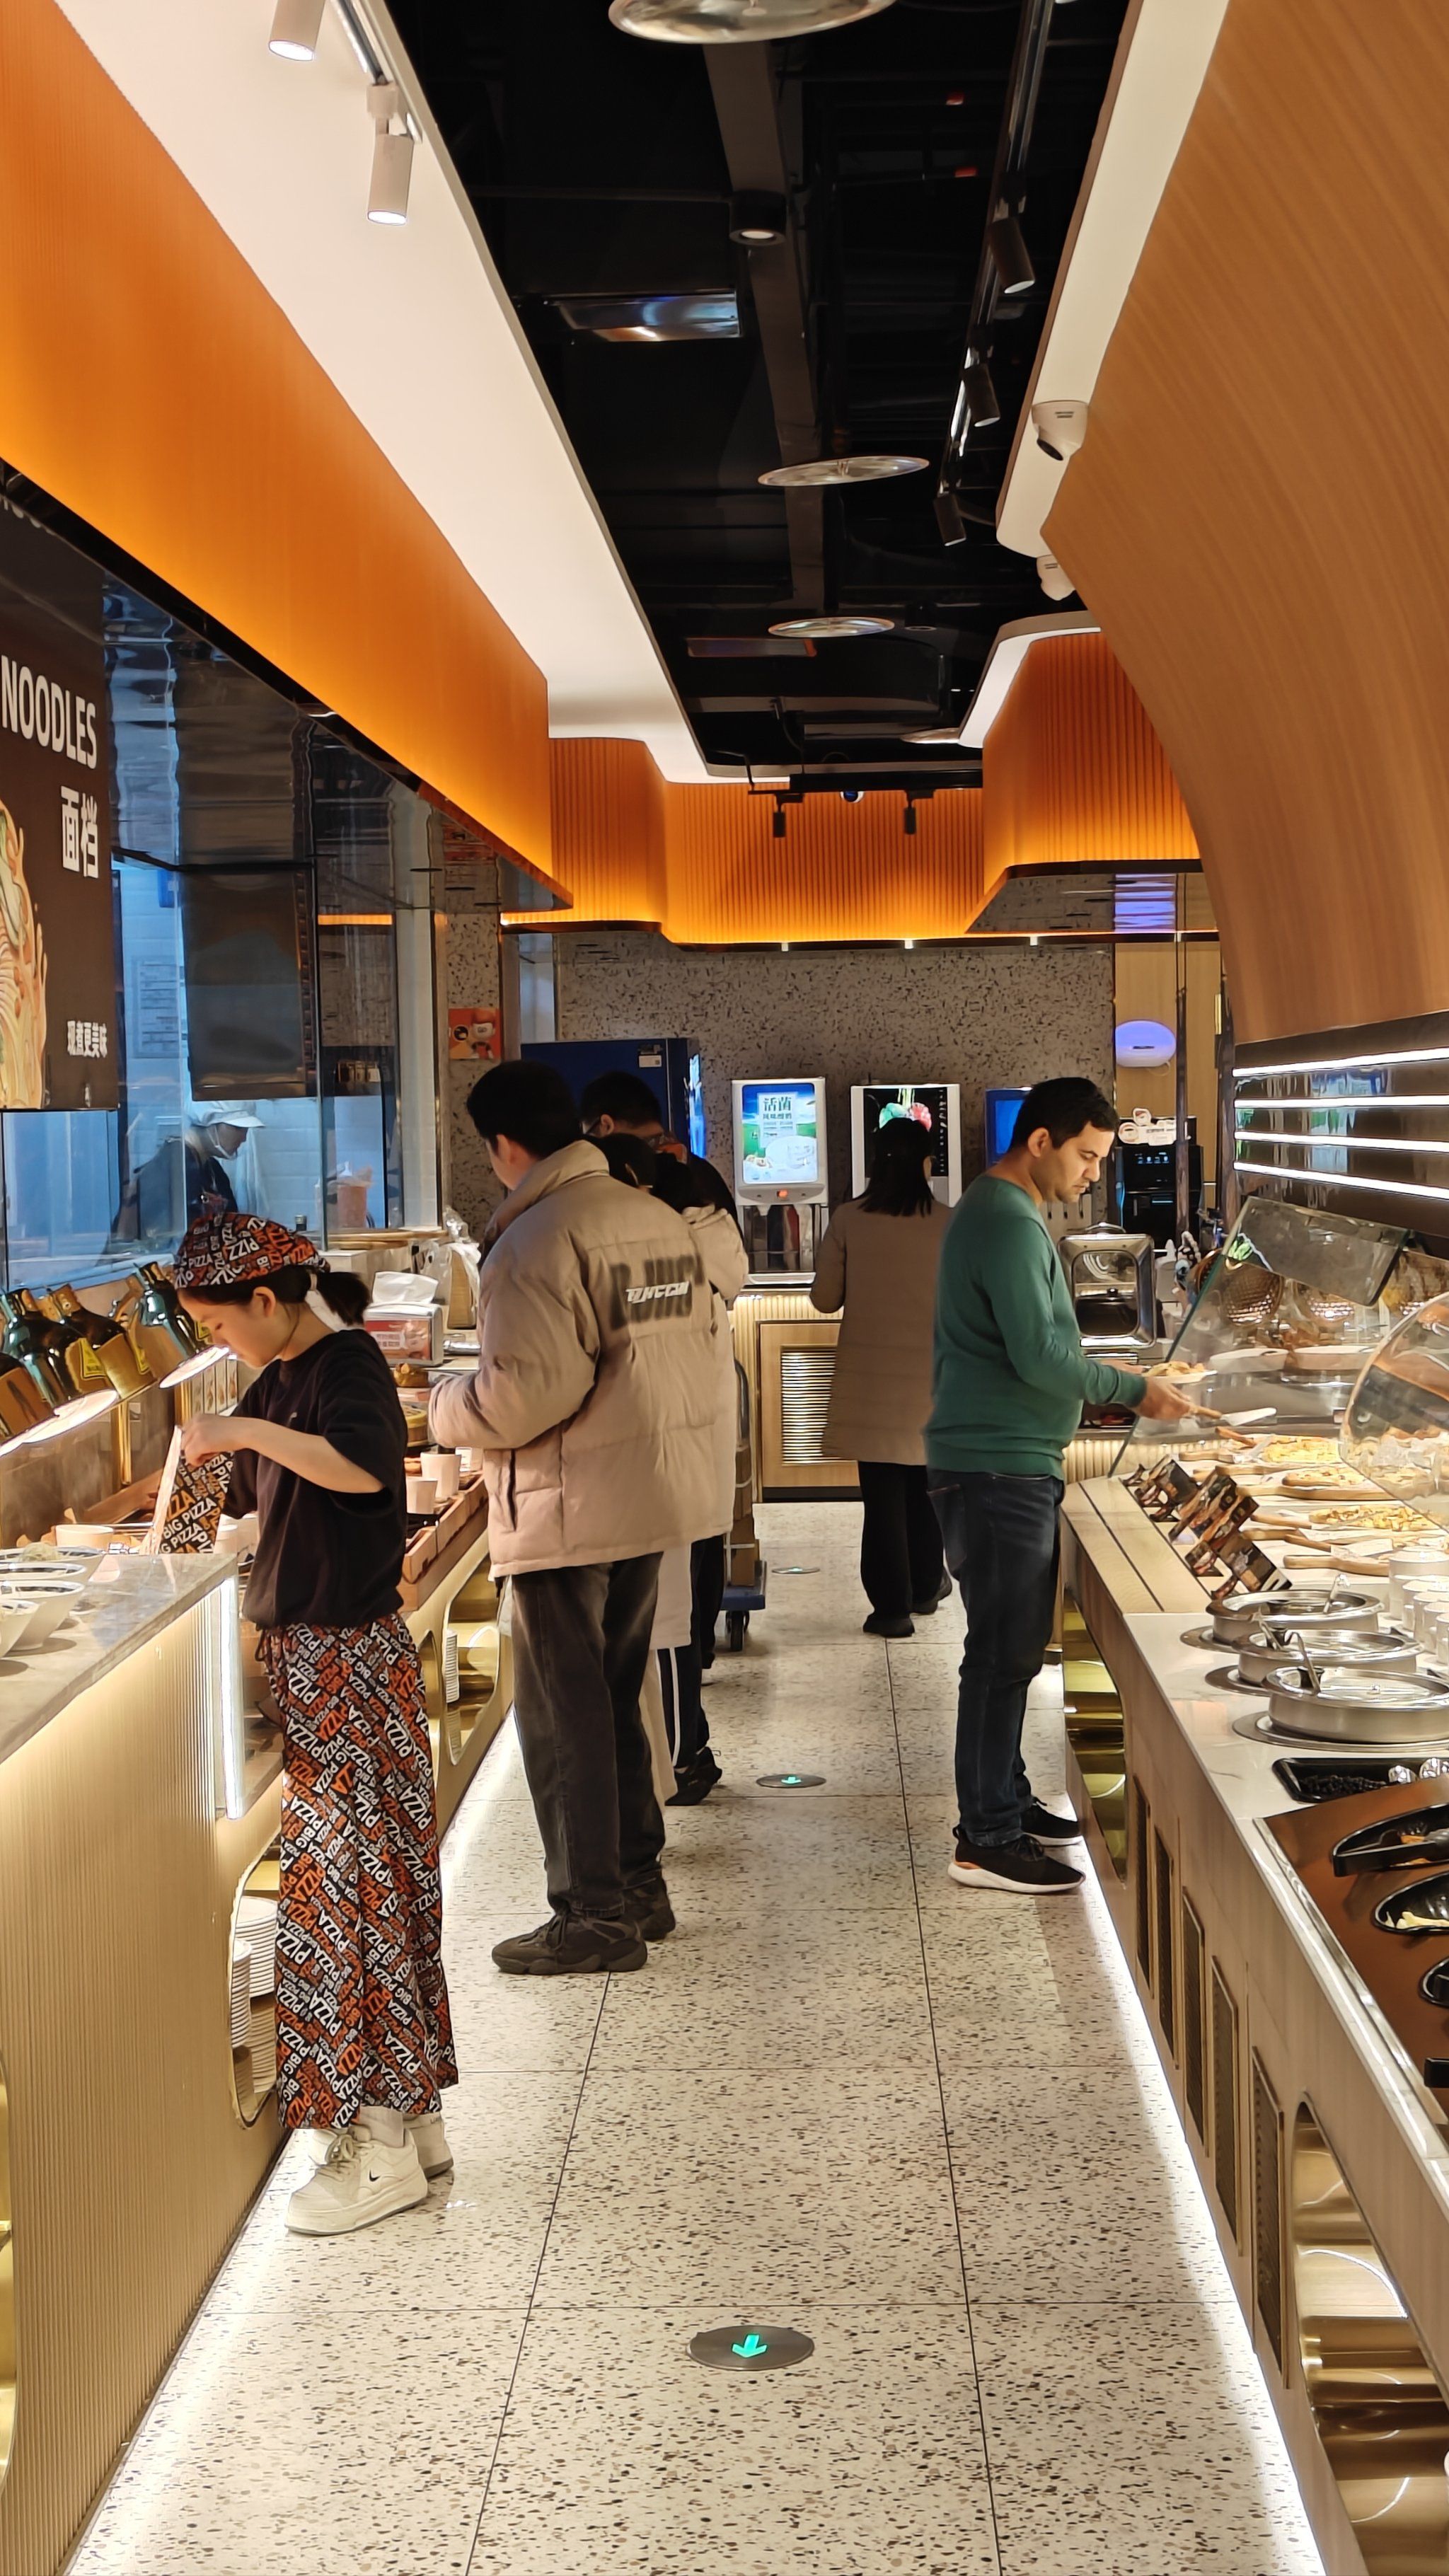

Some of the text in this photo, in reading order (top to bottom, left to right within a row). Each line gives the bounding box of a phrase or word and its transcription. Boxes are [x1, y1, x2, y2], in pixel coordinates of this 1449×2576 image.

[1, 654, 97, 769] NOODLES
[61, 785, 98, 878] 面档
[188, 1252, 214, 1269] PIZZA
[163, 1497, 217, 1540] BIG PIZZA
[170, 1523, 203, 1548] PIZZA
[287, 1718, 325, 1758] PIZZA
[384, 1713, 413, 1757] PIZZA
[312, 1761, 339, 1794] PIZZA
[290, 1796, 324, 1830] PIZZA
[399, 1785, 432, 1830] PIZZA
[296, 1826, 316, 1848] BIG
[293, 1853, 313, 1874] BIG
[307, 1842, 329, 1868] PIZZA
[289, 1861, 326, 1902] PIZZA
[327, 1864, 341, 1882] BIG
[322, 1878, 341, 1903] PIZZA
[287, 1900, 318, 1930] PIZZA
[318, 1910, 351, 1953] PIZZA
[314, 1945, 340, 1982] PIZZA
[373, 1965, 398, 1991] PIZZA
[277, 1982, 305, 2014] PIZZA
[388, 1999, 412, 2025] PIZZA
[395, 1987, 412, 2005] BIG
[309, 1991, 342, 2037] PIZZA
[279, 2021, 311, 2057] PIZZA
[385, 2031, 422, 2074] PIZZA
[284, 2052, 302, 2074] BIG
[316, 2048, 344, 2093] PIZZA
[283, 2079, 300, 2101] BIG
[335, 2067, 362, 2100] PIZZA
[330, 2096, 359, 2129] PIZZA
